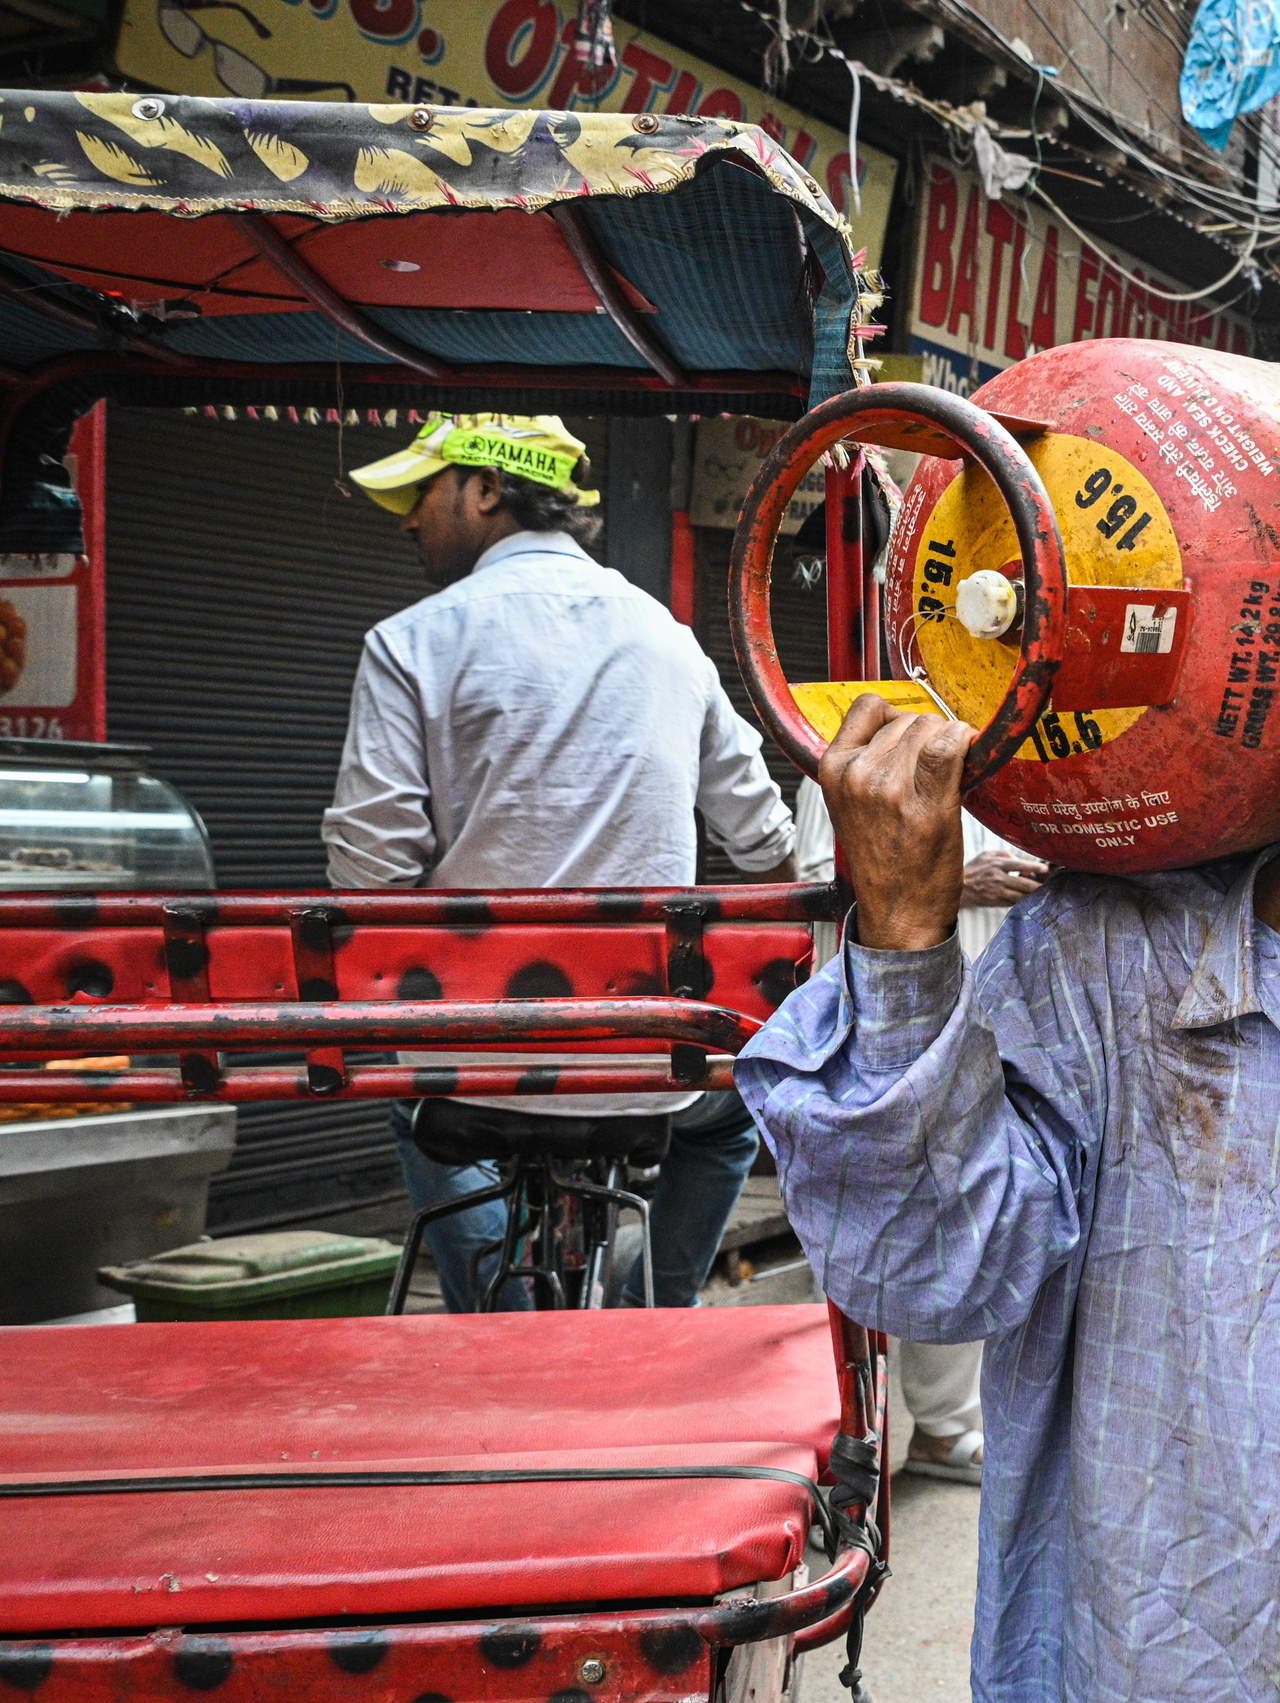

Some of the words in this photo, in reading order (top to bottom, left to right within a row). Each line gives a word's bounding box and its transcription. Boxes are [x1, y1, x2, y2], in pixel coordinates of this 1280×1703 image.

[919, 163, 1058, 362] BATLA
[1156, 373, 1185, 395] AND
[1146, 397, 1173, 423] जांच
[1211, 405, 1235, 427] ON
[1133, 411, 1166, 444] समय
[1169, 420, 1188, 441] की
[461, 455, 509, 467] FACTORY
[487, 440, 557, 475] YAMAHA
[1160, 440, 1185, 465] लेते
[1206, 424, 1250, 471] CHECK
[1226, 424, 1274, 477] WEIGHT
[1211, 470, 1238, 497] और
[1074, 467, 1153, 552] 15.6
[918, 539, 958, 623] 15.6
[1243, 580, 1271, 606] kg
[1236, 607, 1262, 647] 142
[1227, 651, 1253, 684] WT.
[1255, 651, 1280, 684] WT.
[1215, 687, 1245, 739] NETT
[1030, 710, 1103, 764] 15.6
[1020, 797, 1050, 815] केवल
[1081, 796, 1125, 816] उपयोग
[1126, 794, 1141, 811] के
[1141, 790, 1171, 807] लिए
[1031, 821, 1060, 834] FOR
[1061, 819, 1142, 835] DOMESTIC
[1144, 812, 1179, 828] USE
[1095, 835, 1136, 848] ONLY
